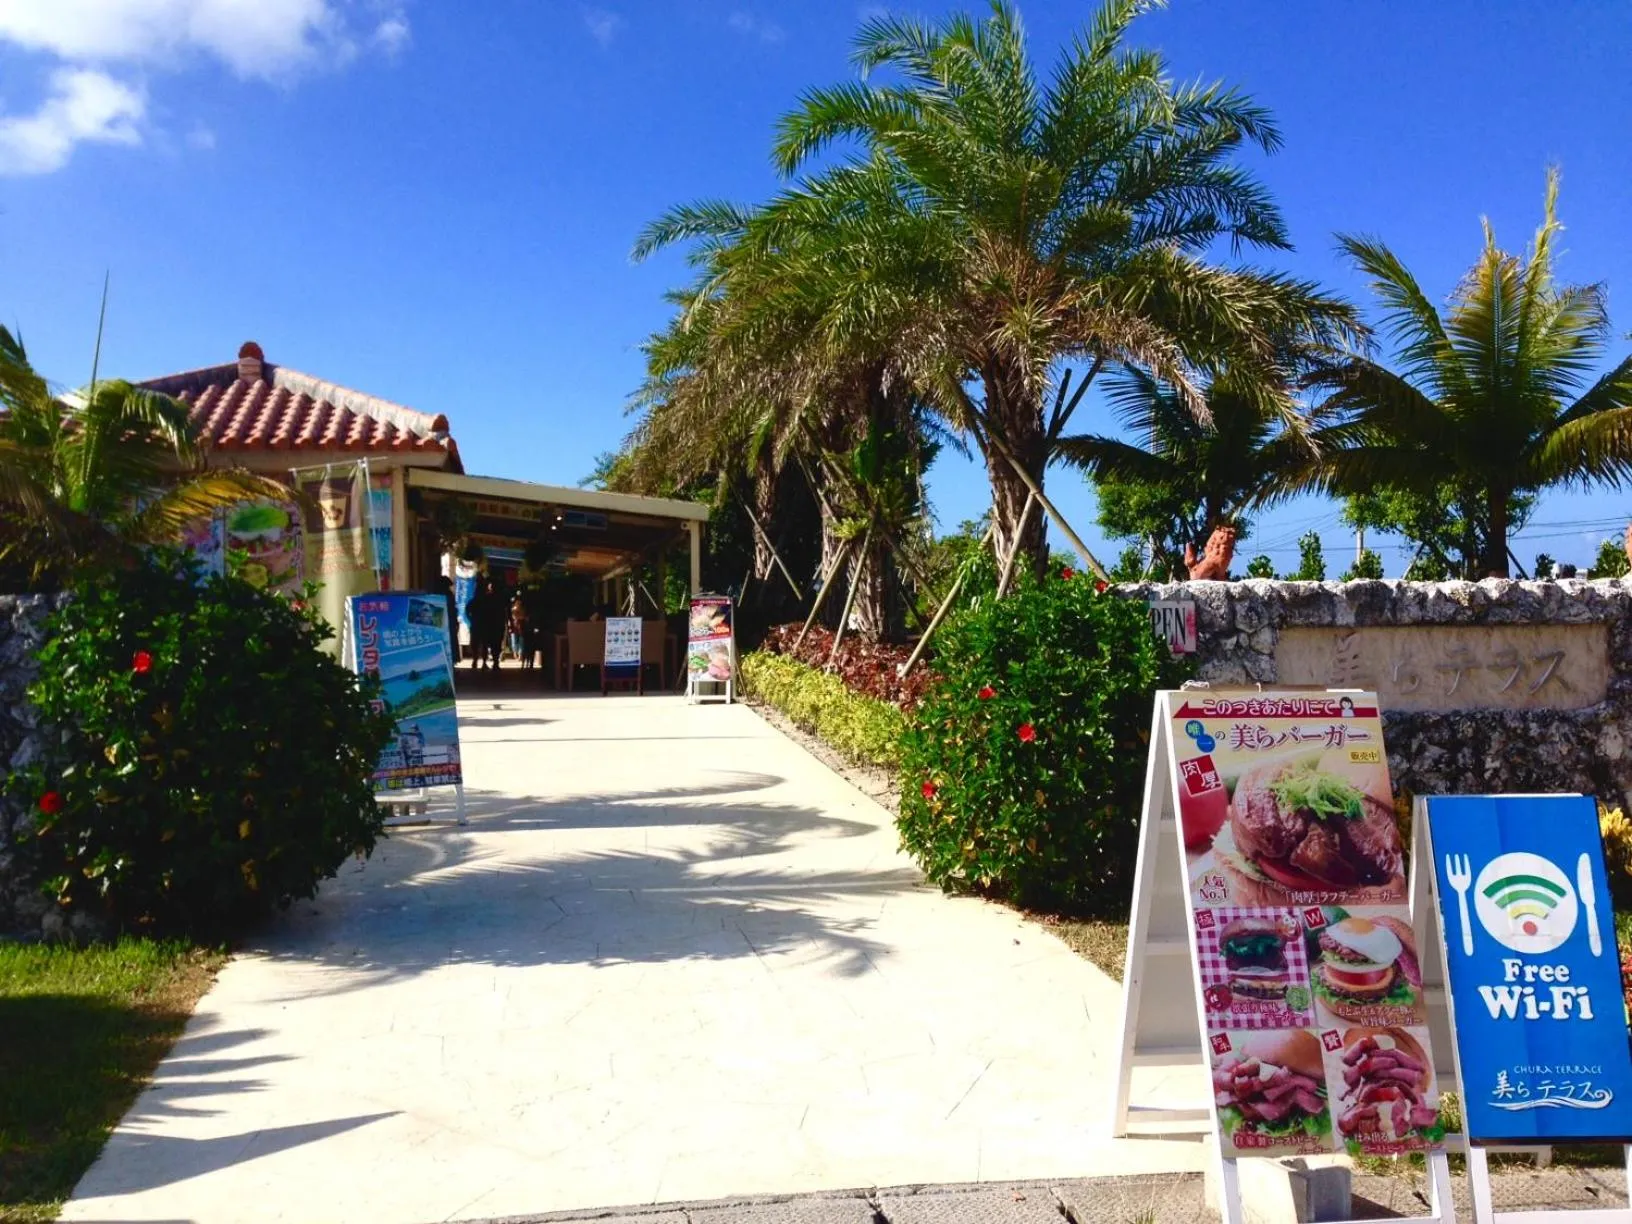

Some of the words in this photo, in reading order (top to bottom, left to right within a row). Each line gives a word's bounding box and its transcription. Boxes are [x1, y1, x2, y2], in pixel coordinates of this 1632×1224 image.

[1203, 698, 1335, 716] このつきあたりにて
[1350, 751, 1378, 762] 販売中
[1183, 760, 1222, 789] 肉厚
[1203, 874, 1226, 888] 人気
[1200, 887, 1228, 900] No.1
[1306, 911, 1322, 924] W
[1503, 958, 1569, 982] Free
[1478, 985, 1594, 1019] Wi-Fi
[1513, 1065, 1553, 1074] CHURA
[1555, 1065, 1603, 1074] TERRACE
